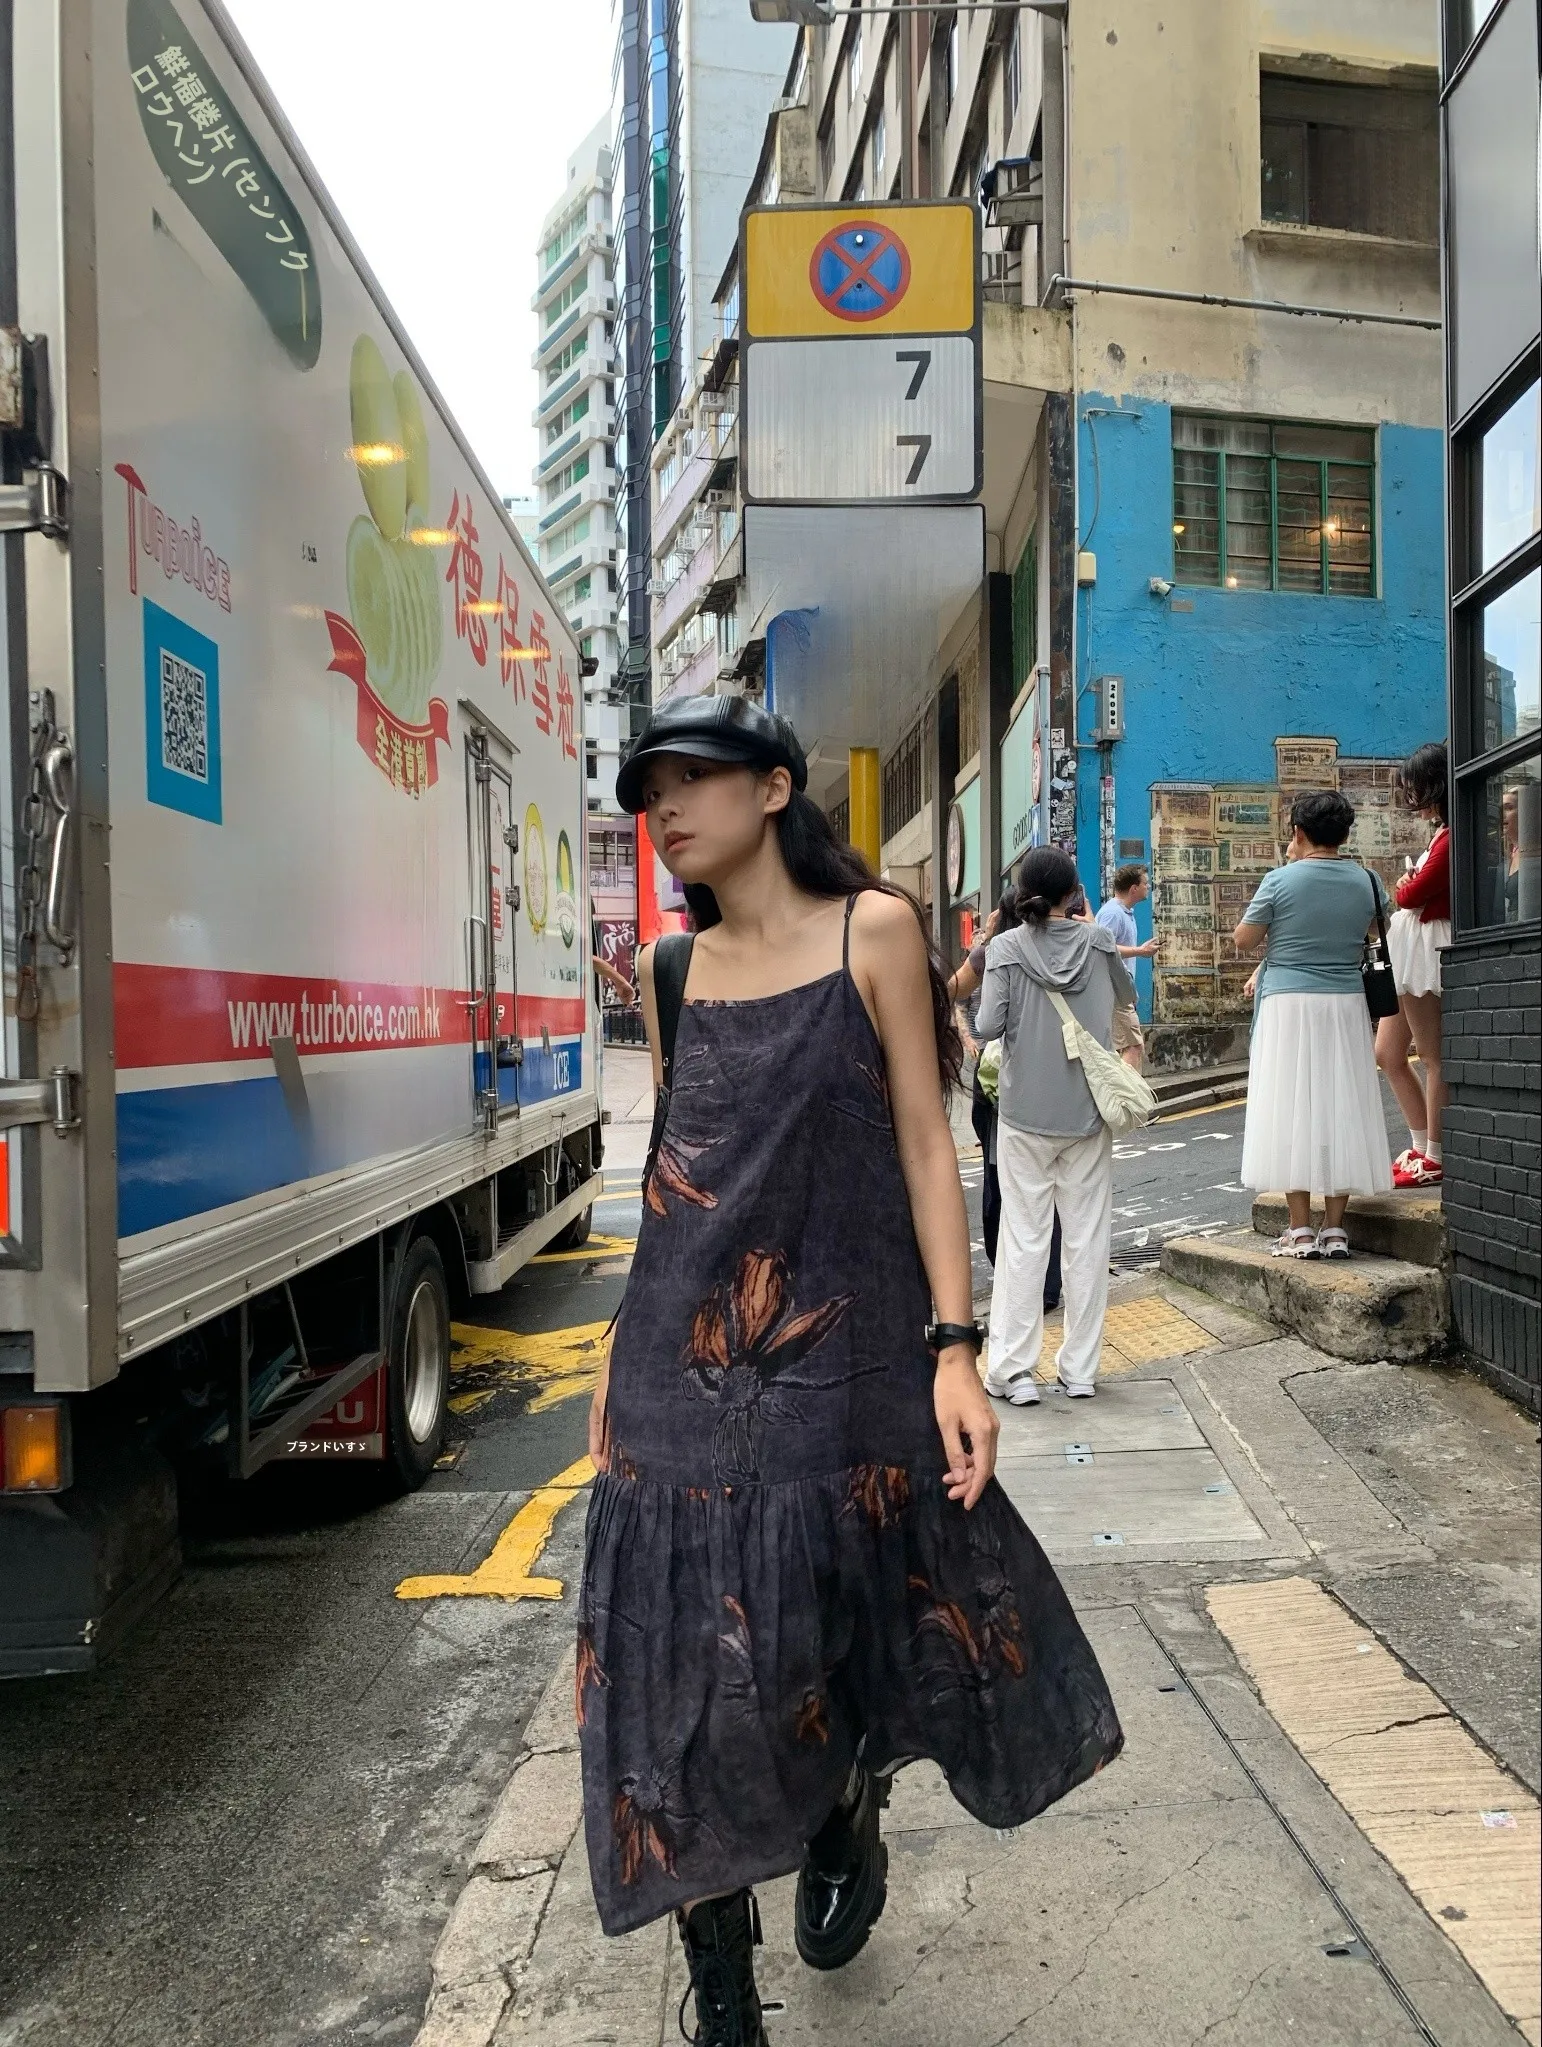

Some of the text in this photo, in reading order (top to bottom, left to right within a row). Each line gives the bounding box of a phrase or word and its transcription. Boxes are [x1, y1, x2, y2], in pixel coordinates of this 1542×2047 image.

[896, 350, 931, 400] 7
[896, 434, 931, 485] 7
[228, 986, 441, 1048] www.turboice.com.hk
[552, 1050, 570, 1091] ICE
